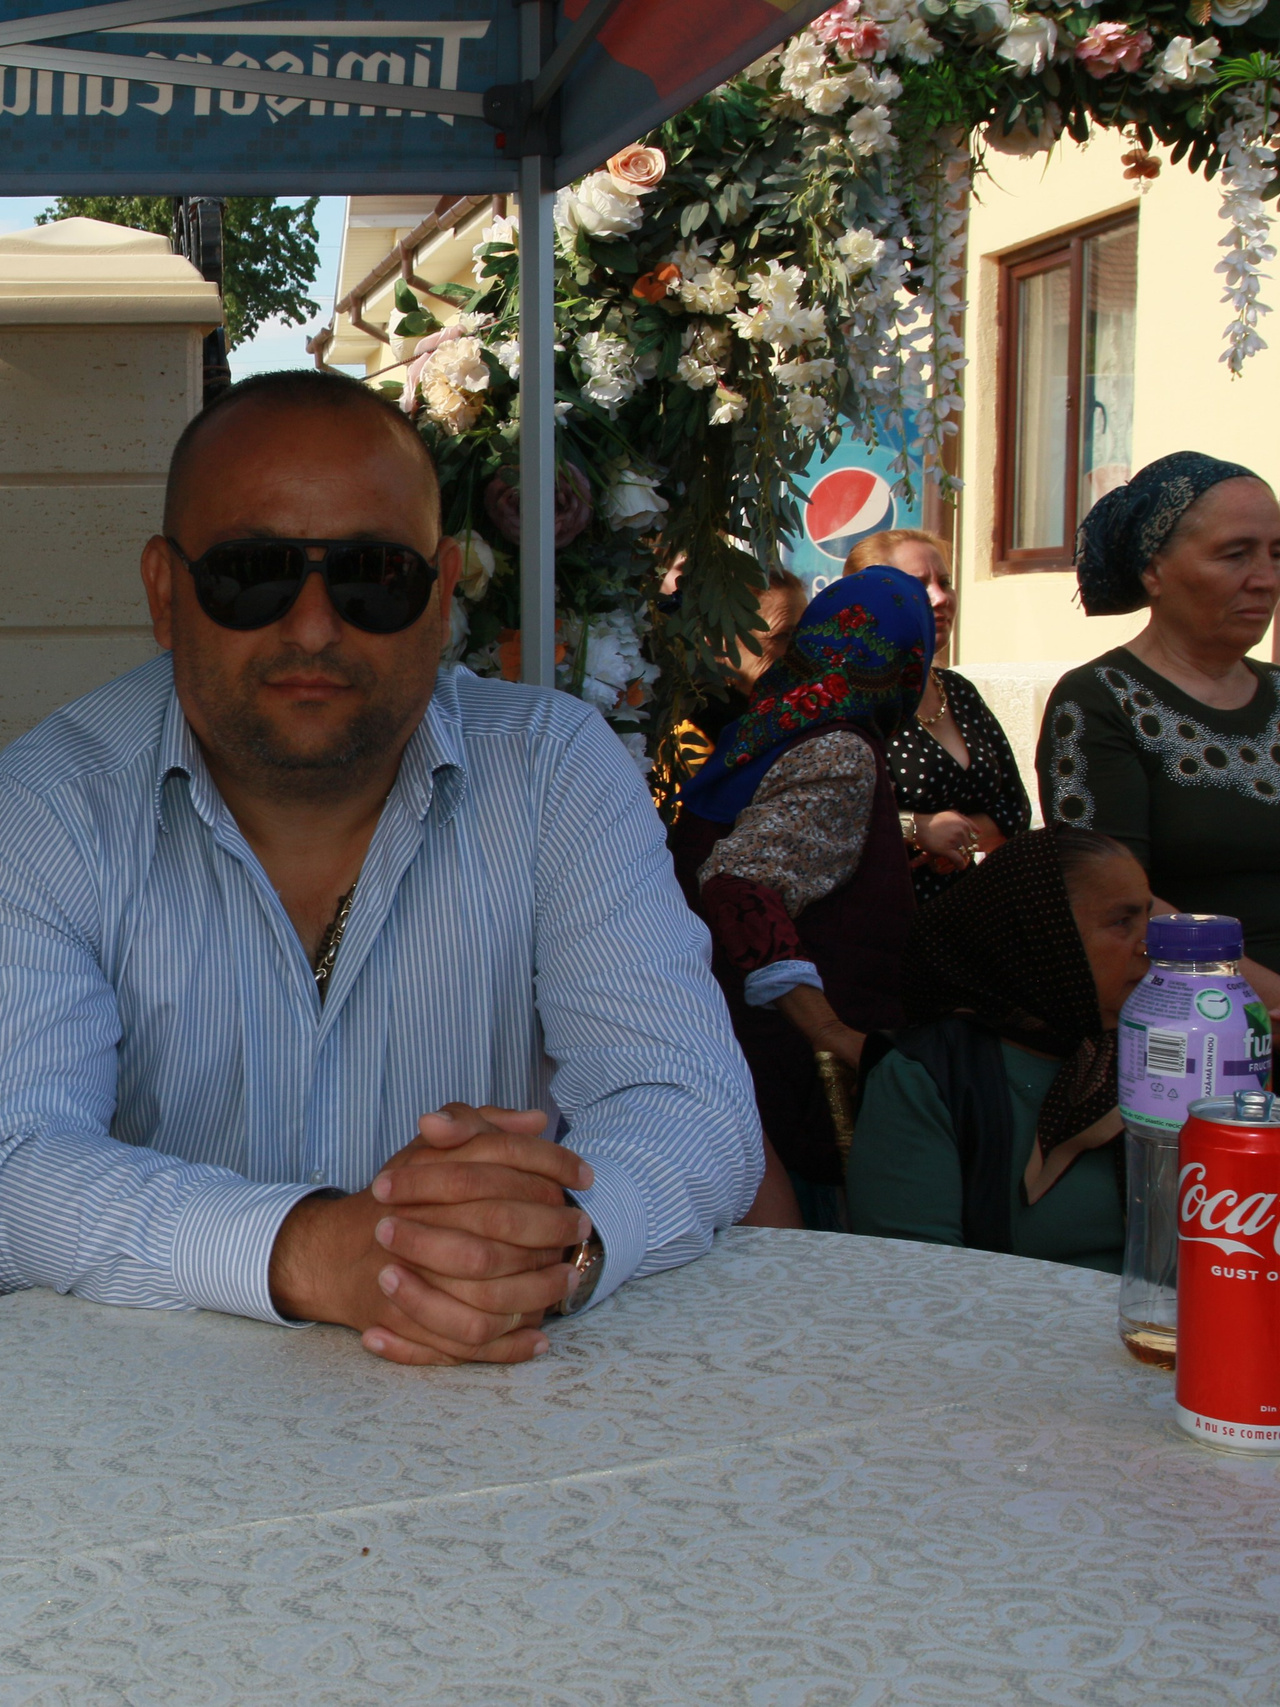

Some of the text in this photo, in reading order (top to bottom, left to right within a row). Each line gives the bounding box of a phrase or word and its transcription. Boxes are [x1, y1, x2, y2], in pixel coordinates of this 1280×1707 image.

[1243, 1028, 1272, 1058] fuz
[1204, 1037, 1215, 1097] AZĂ-MĂ DIN NOU
[1178, 1162, 1280, 1250] Coca
[1211, 1265, 1259, 1281] GUST
[1260, 1405, 1277, 1413] Din
[1196, 1416, 1280, 1440] A nu se comer
